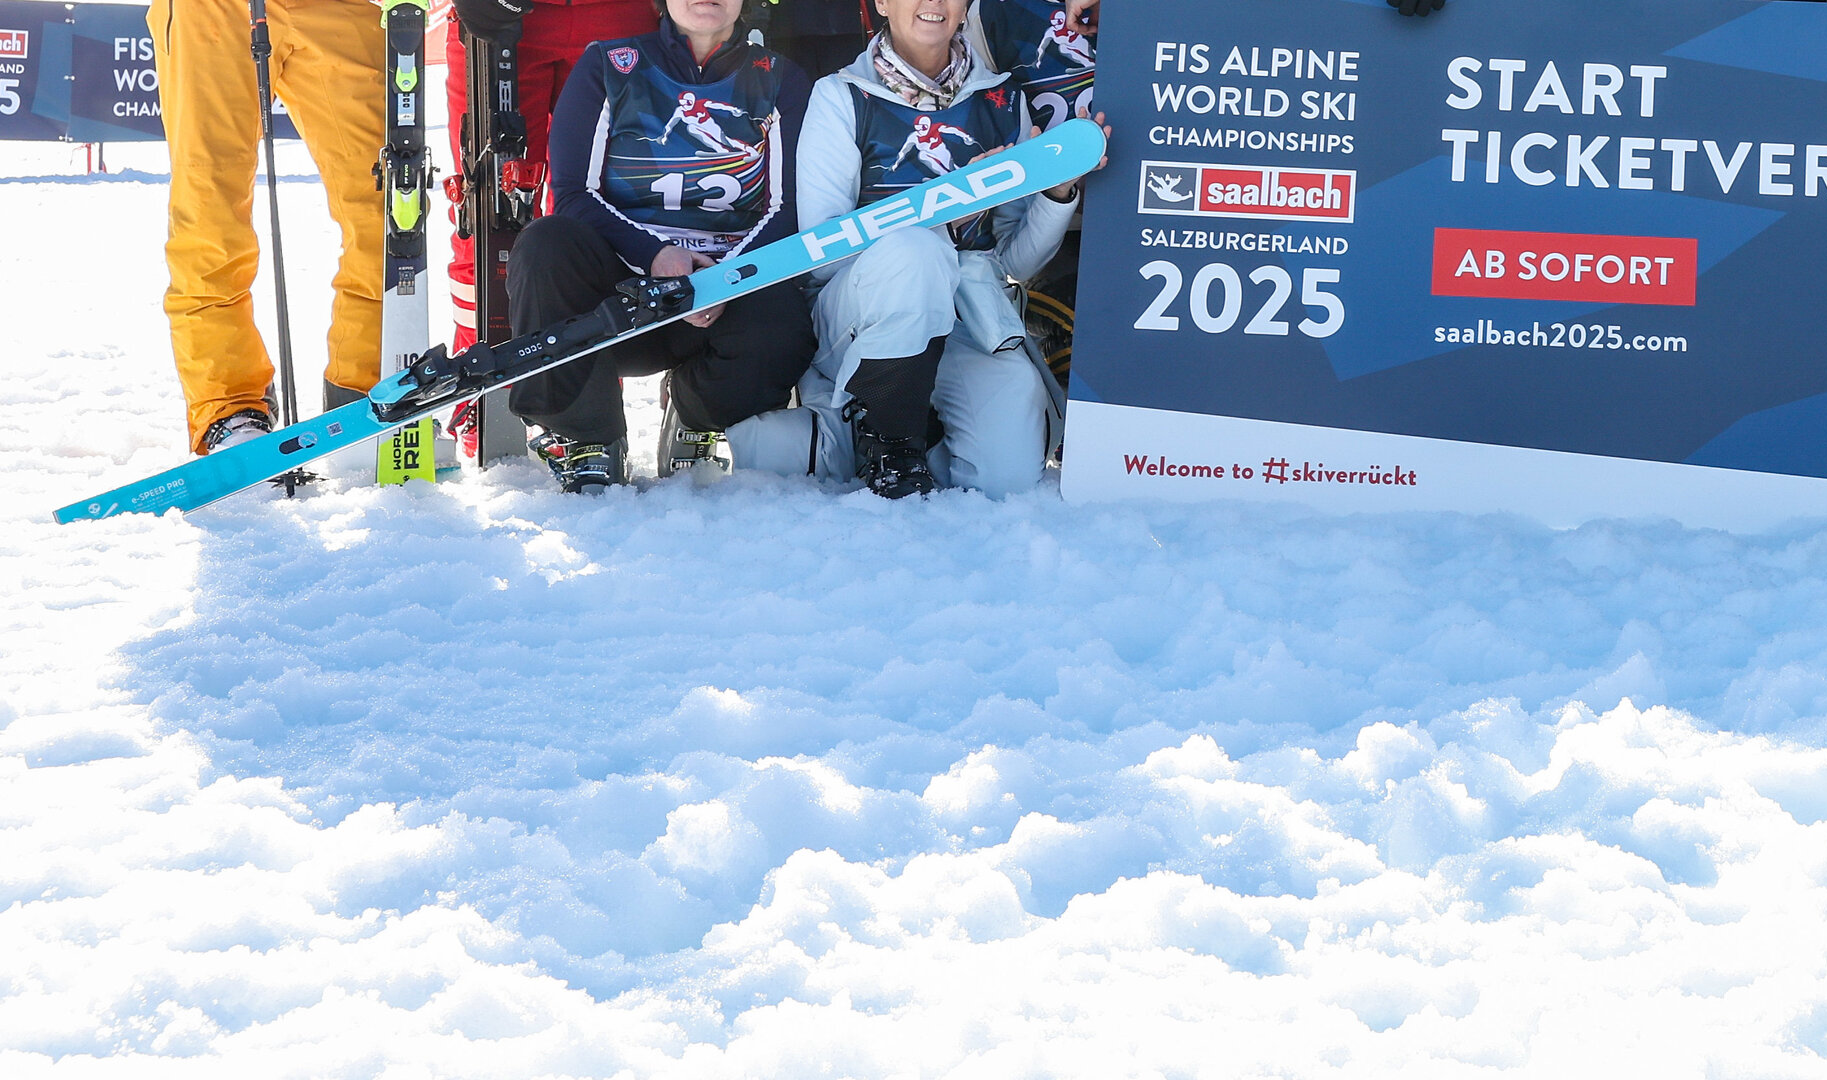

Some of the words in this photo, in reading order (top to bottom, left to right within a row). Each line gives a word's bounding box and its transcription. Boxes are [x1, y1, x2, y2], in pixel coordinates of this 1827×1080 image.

[114, 37, 153, 61] FIS
[1154, 41, 1210, 74] FIS
[1220, 46, 1360, 81] ALPINE
[1152, 83, 1290, 119] WORLD
[1300, 88, 1356, 121] SKI
[1445, 56, 1667, 119] START
[1148, 125, 1355, 155] CHAMPIONSHIPS
[1206, 169, 1343, 211] saalbach
[800, 160, 1026, 262] HEAD
[1140, 228, 1349, 256] SALZBURGERLAND
[1455, 248, 1505, 280] AB
[1517, 251, 1674, 287] SOFORT
[647, 286, 660, 297] 14
[1133, 259, 1346, 339] 2025
[1433, 319, 1688, 354] saalbach2025.com
[1124, 453, 1226, 480] Welcome
[1232, 461, 1254, 480] to
[1262, 456, 1418, 487] #skiverrückt
[131, 483, 166, 504] e-SPEED
[166, 478, 185, 494] PRO
